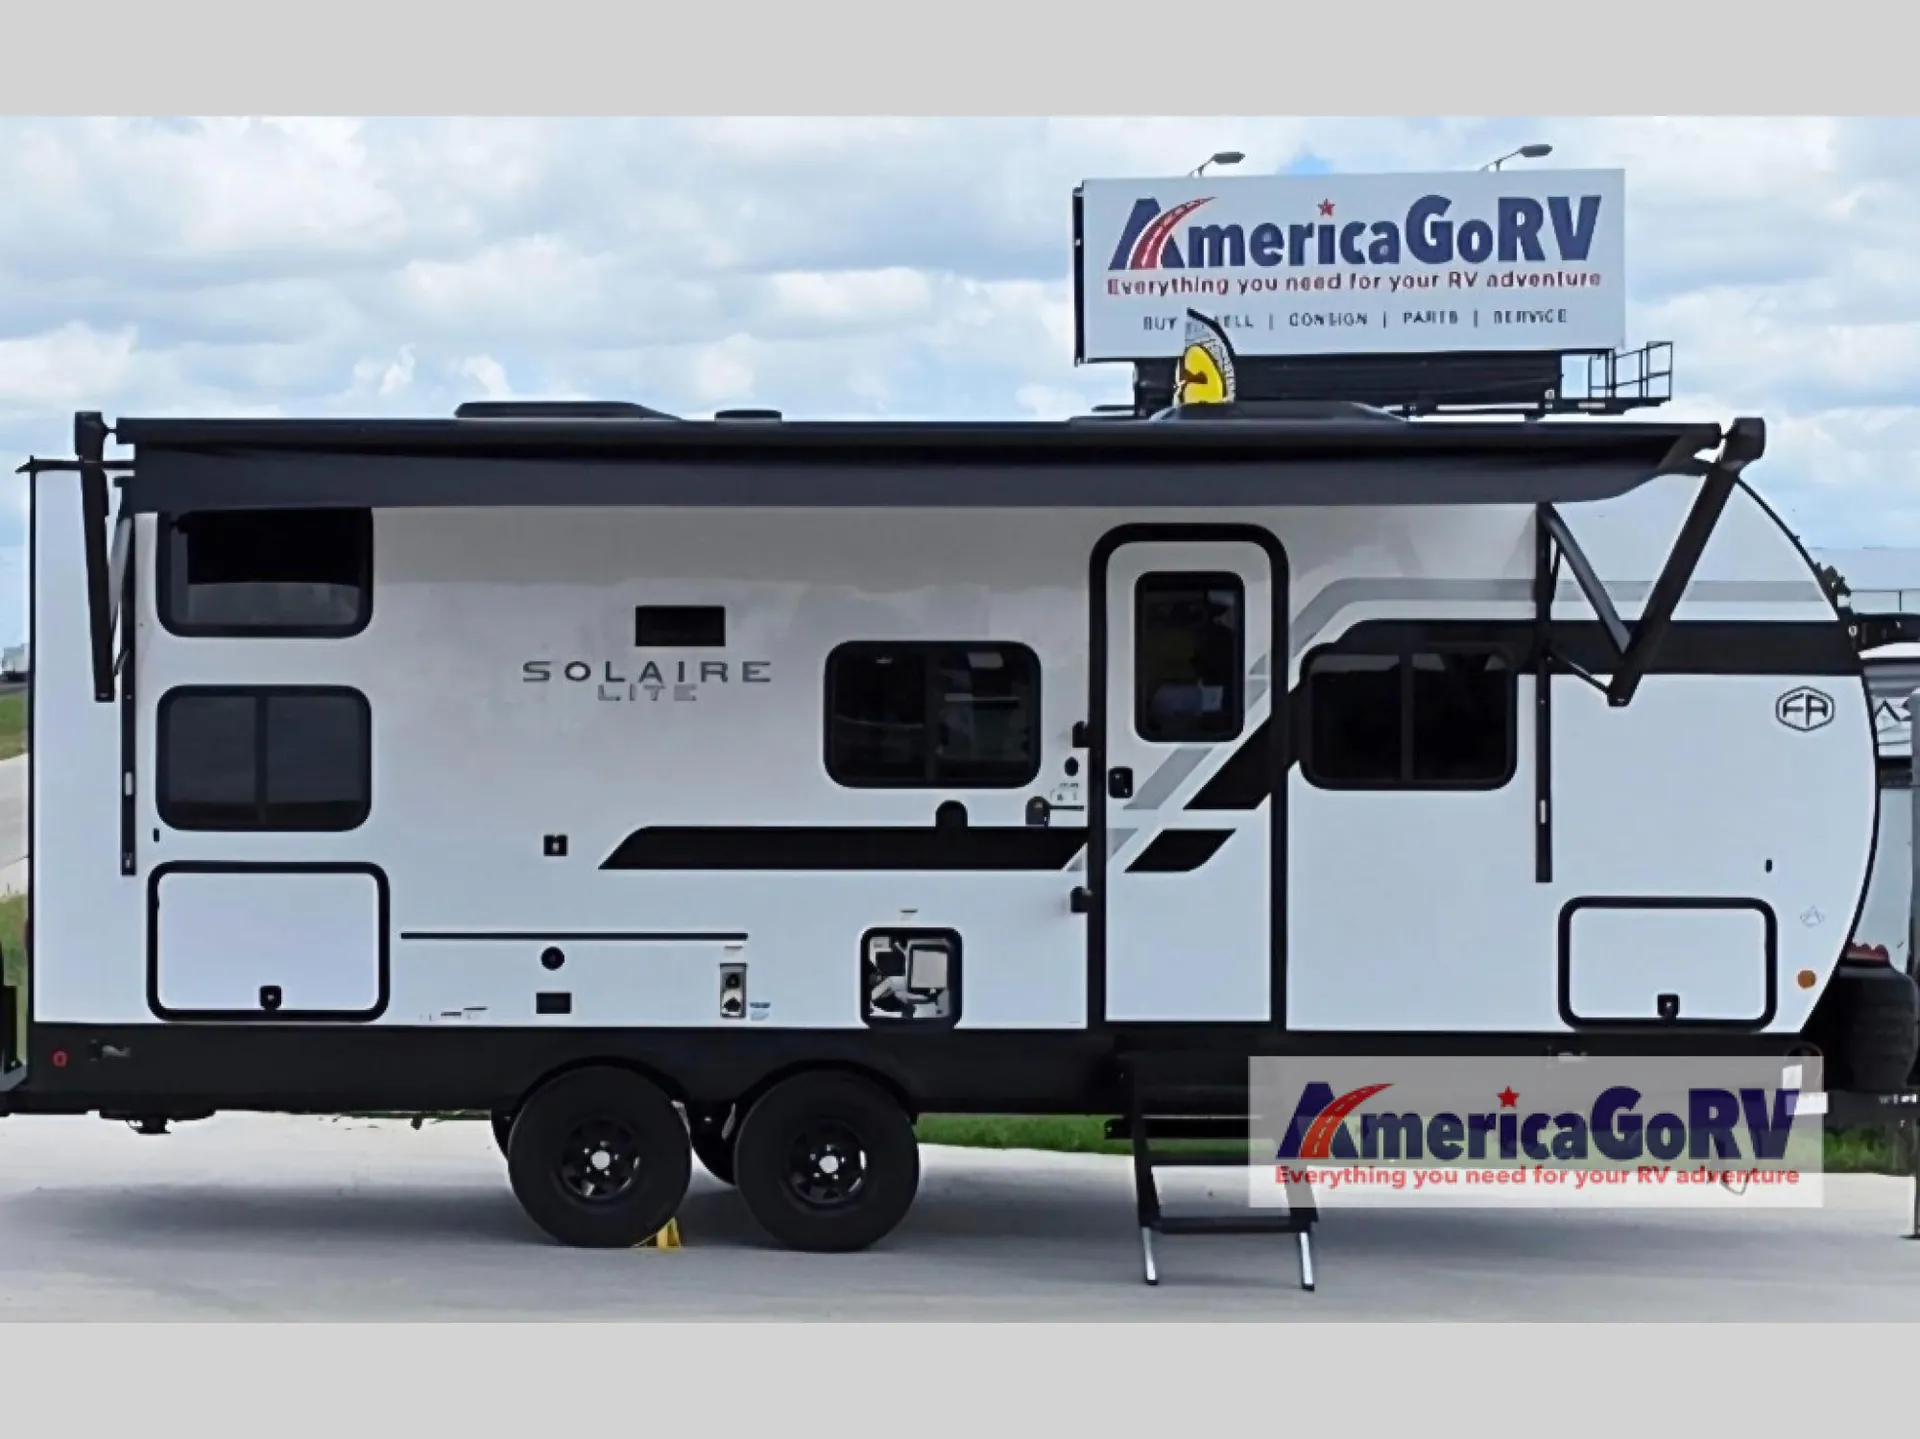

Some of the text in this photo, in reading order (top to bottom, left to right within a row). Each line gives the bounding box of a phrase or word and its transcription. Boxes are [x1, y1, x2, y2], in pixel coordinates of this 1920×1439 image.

[1108, 195, 1602, 270] AmericaGoRV
[1107, 270, 1602, 297] Everything you need for your RV adventure
[522, 660, 772, 683] SOLAIRE
[598, 684, 698, 702] LITE
